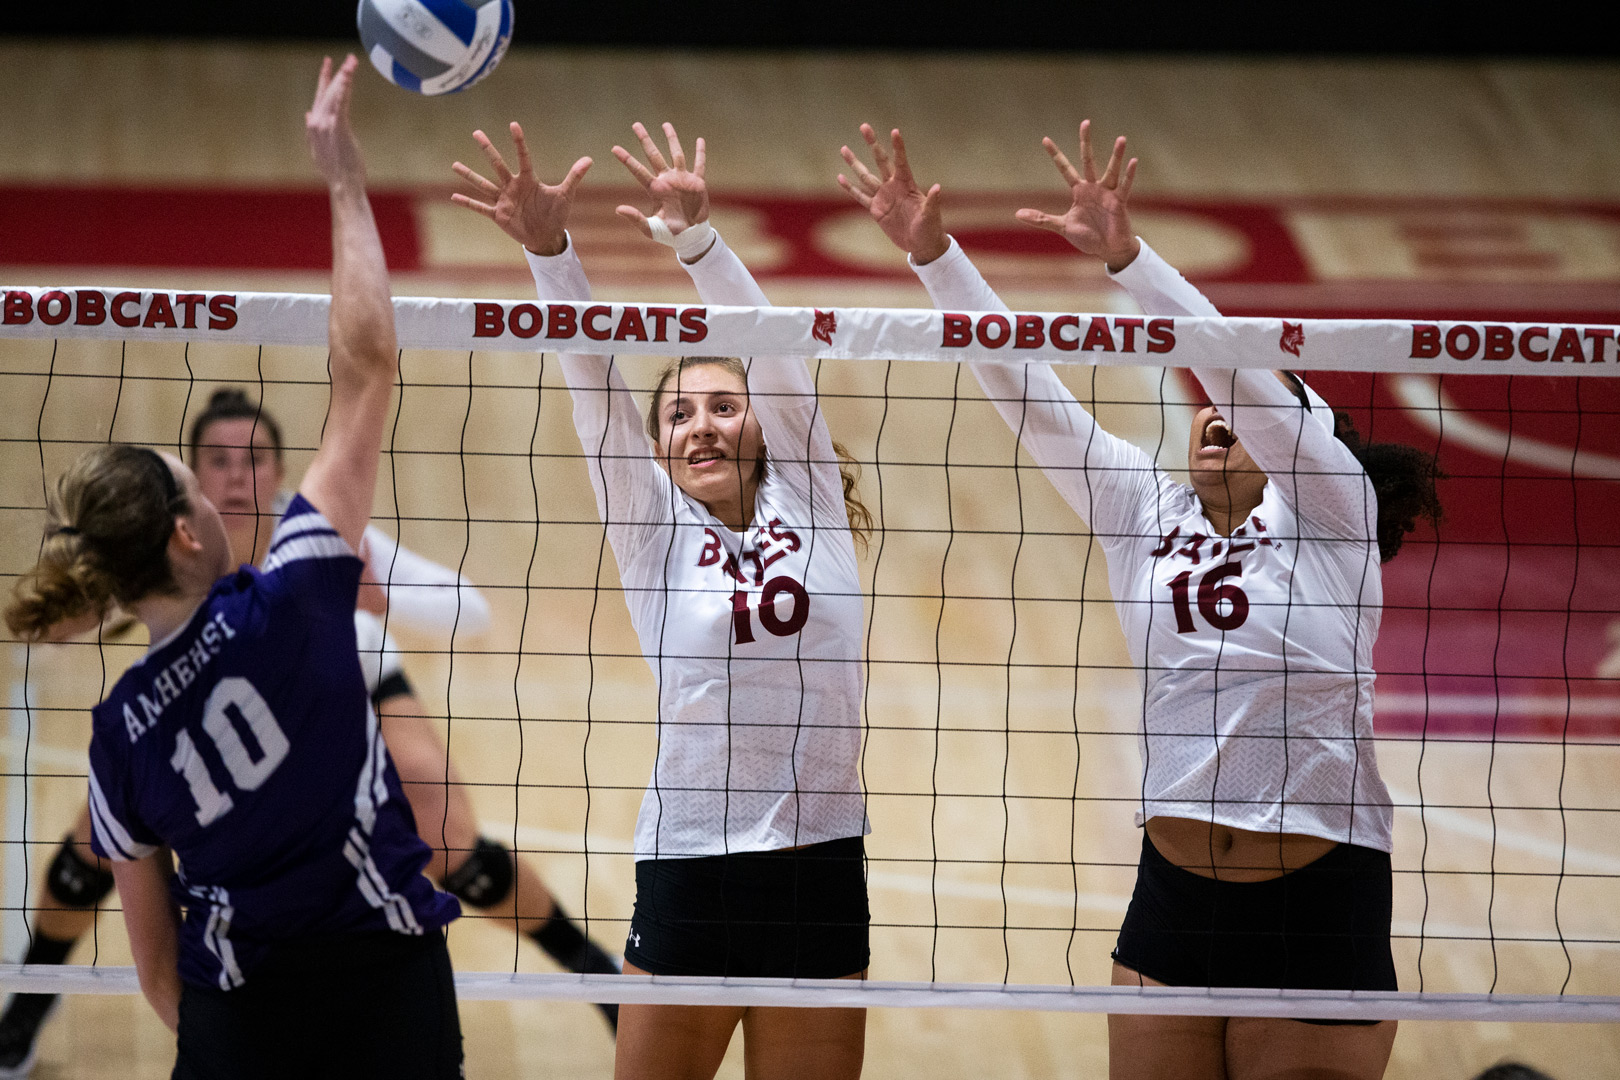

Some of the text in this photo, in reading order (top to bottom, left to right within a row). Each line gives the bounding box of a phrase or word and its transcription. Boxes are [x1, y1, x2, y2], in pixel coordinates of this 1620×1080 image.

[2, 290, 238, 330] BOBCATS
[472, 302, 708, 343] BOBCATS
[940, 312, 1176, 354] BOBCATS
[1409, 324, 1620, 363] BOBCAT
[728, 575, 810, 645] 10
[1166, 560, 1250, 634] 16
[169, 676, 291, 828] 10
